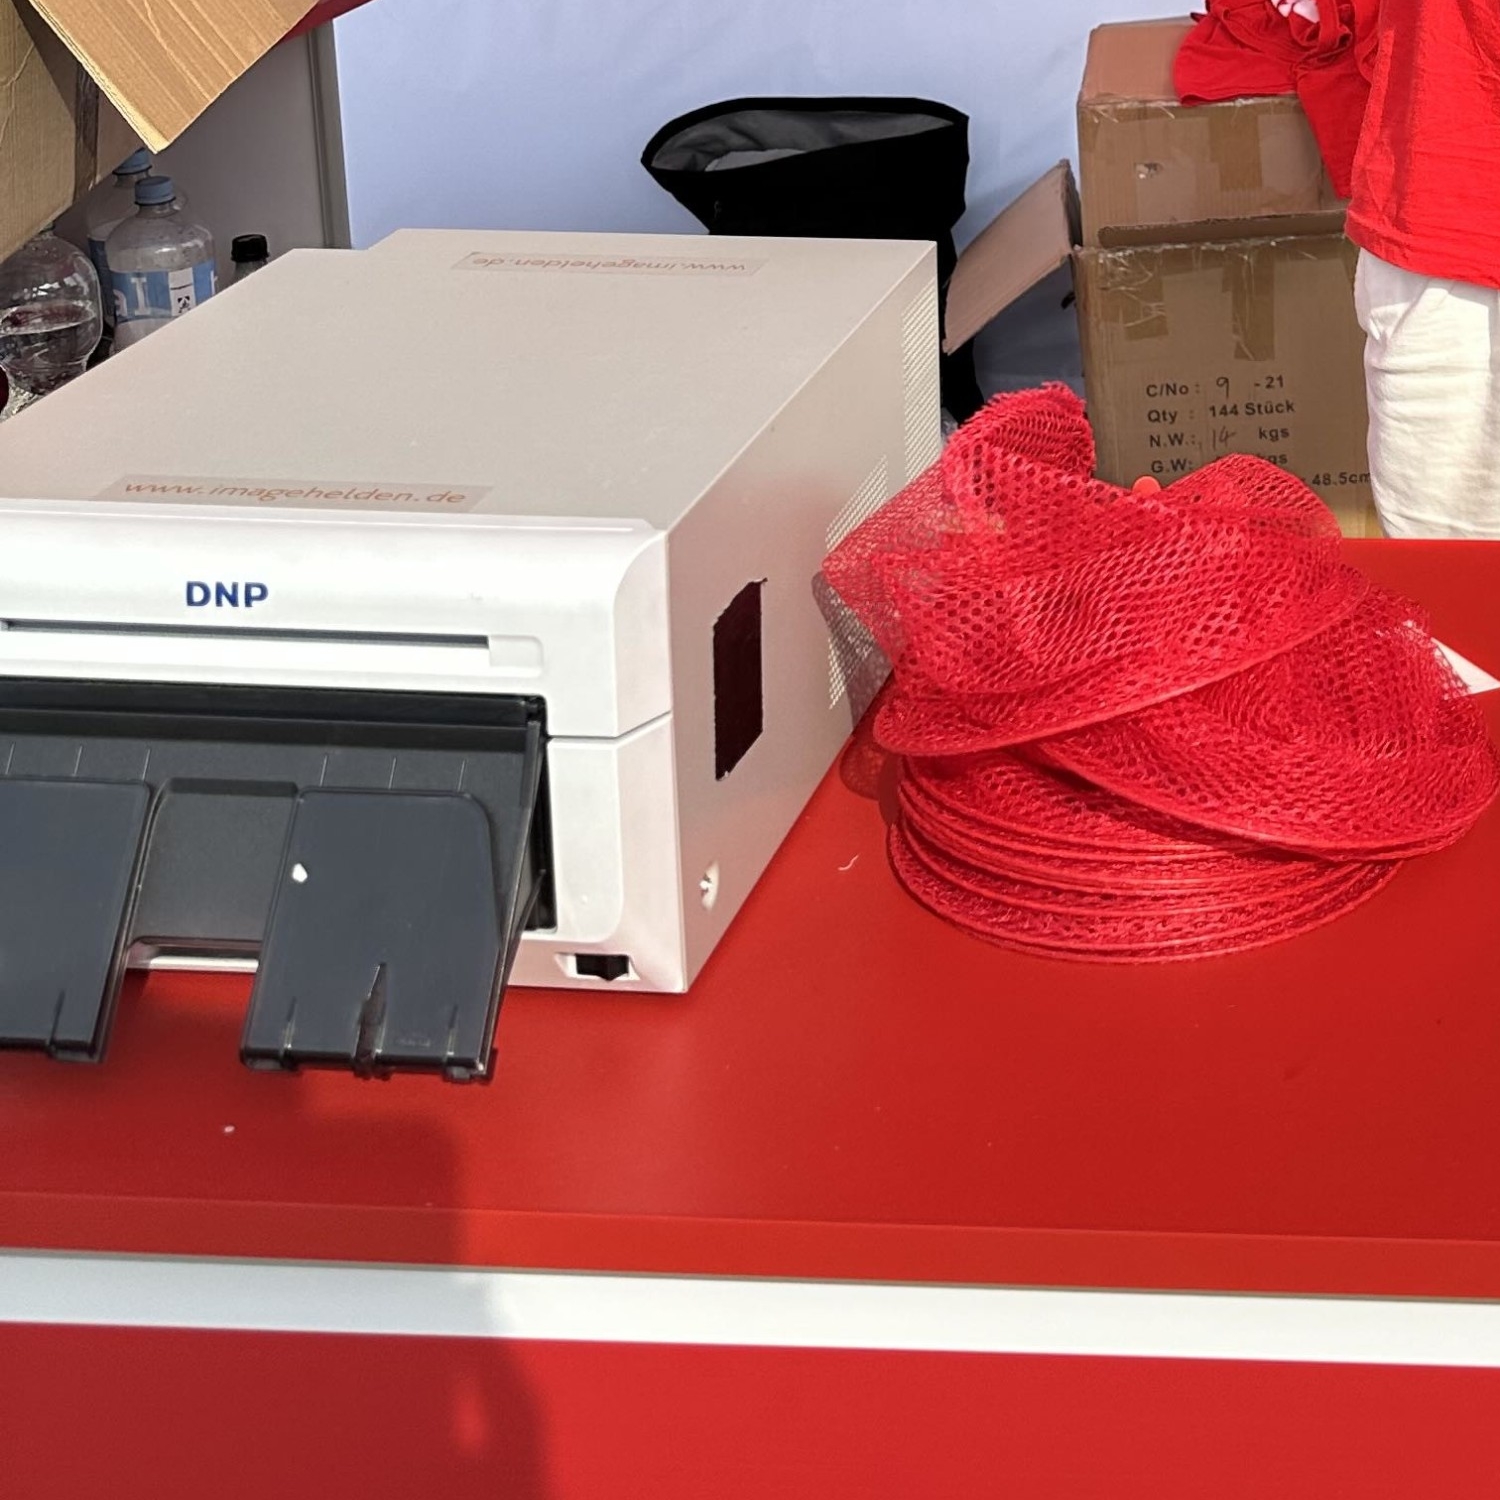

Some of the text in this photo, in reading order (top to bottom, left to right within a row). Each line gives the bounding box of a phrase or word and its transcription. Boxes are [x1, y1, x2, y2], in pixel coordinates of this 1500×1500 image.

[472, 257, 746, 272] www.imagehelden.de
[1209, 403, 1239, 418] 144
[1245, 399, 1296, 416] Stück
[1258, 427, 1290, 442] kgs
[1261, 453, 1288, 465] gs
[124, 480, 467, 504] www.imagehelden.de
[185, 580, 270, 608] DNP
